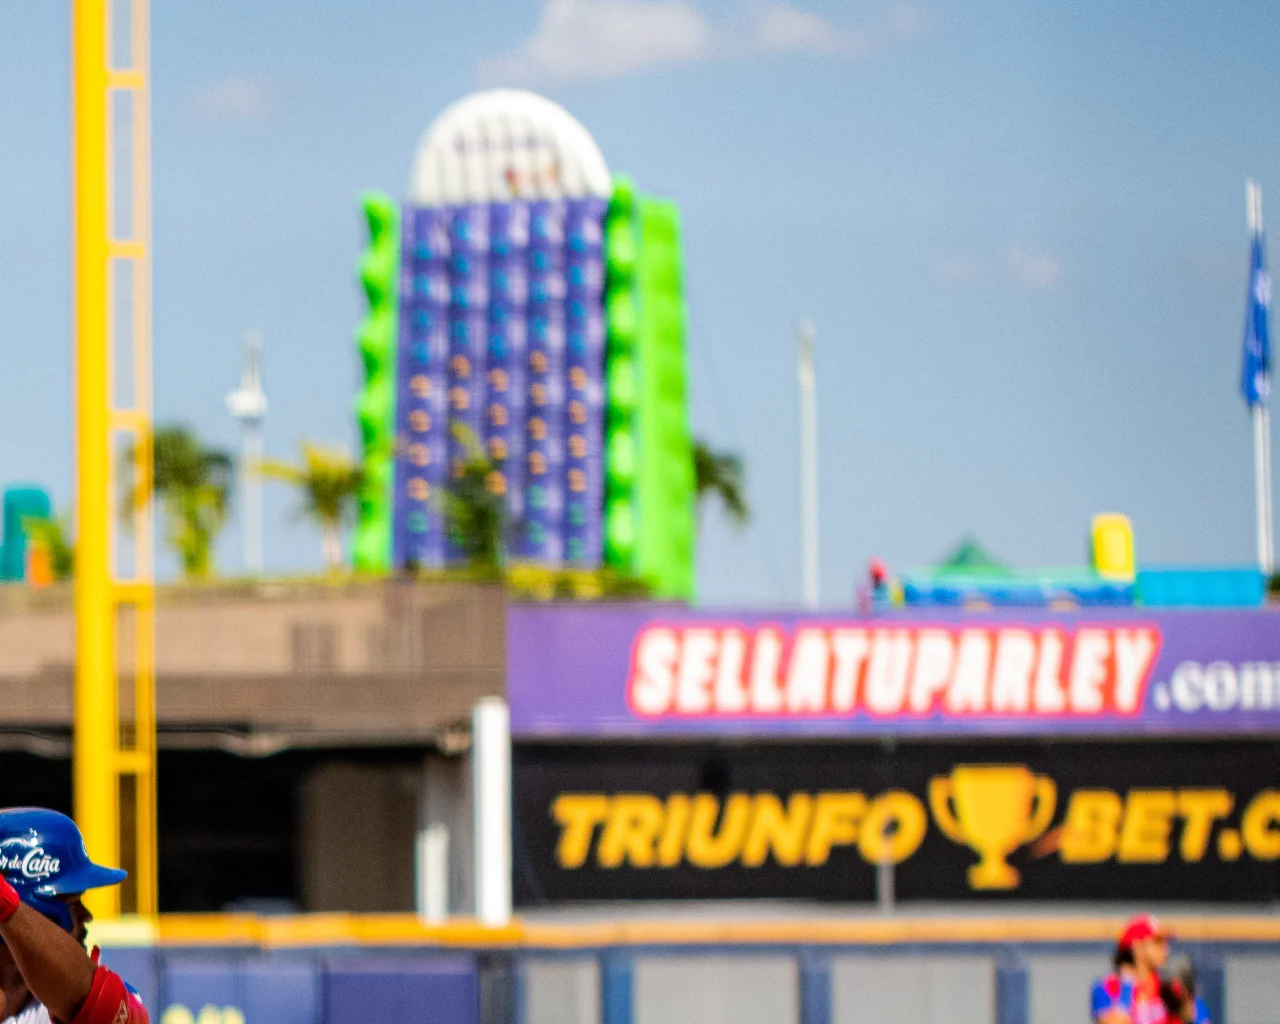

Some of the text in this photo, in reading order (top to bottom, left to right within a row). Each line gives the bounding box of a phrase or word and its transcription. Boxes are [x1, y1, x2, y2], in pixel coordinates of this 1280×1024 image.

[551, 790, 927, 869] TRIUNFO
[8, 853, 22, 869] de
[21, 847, 61, 878] Caña
